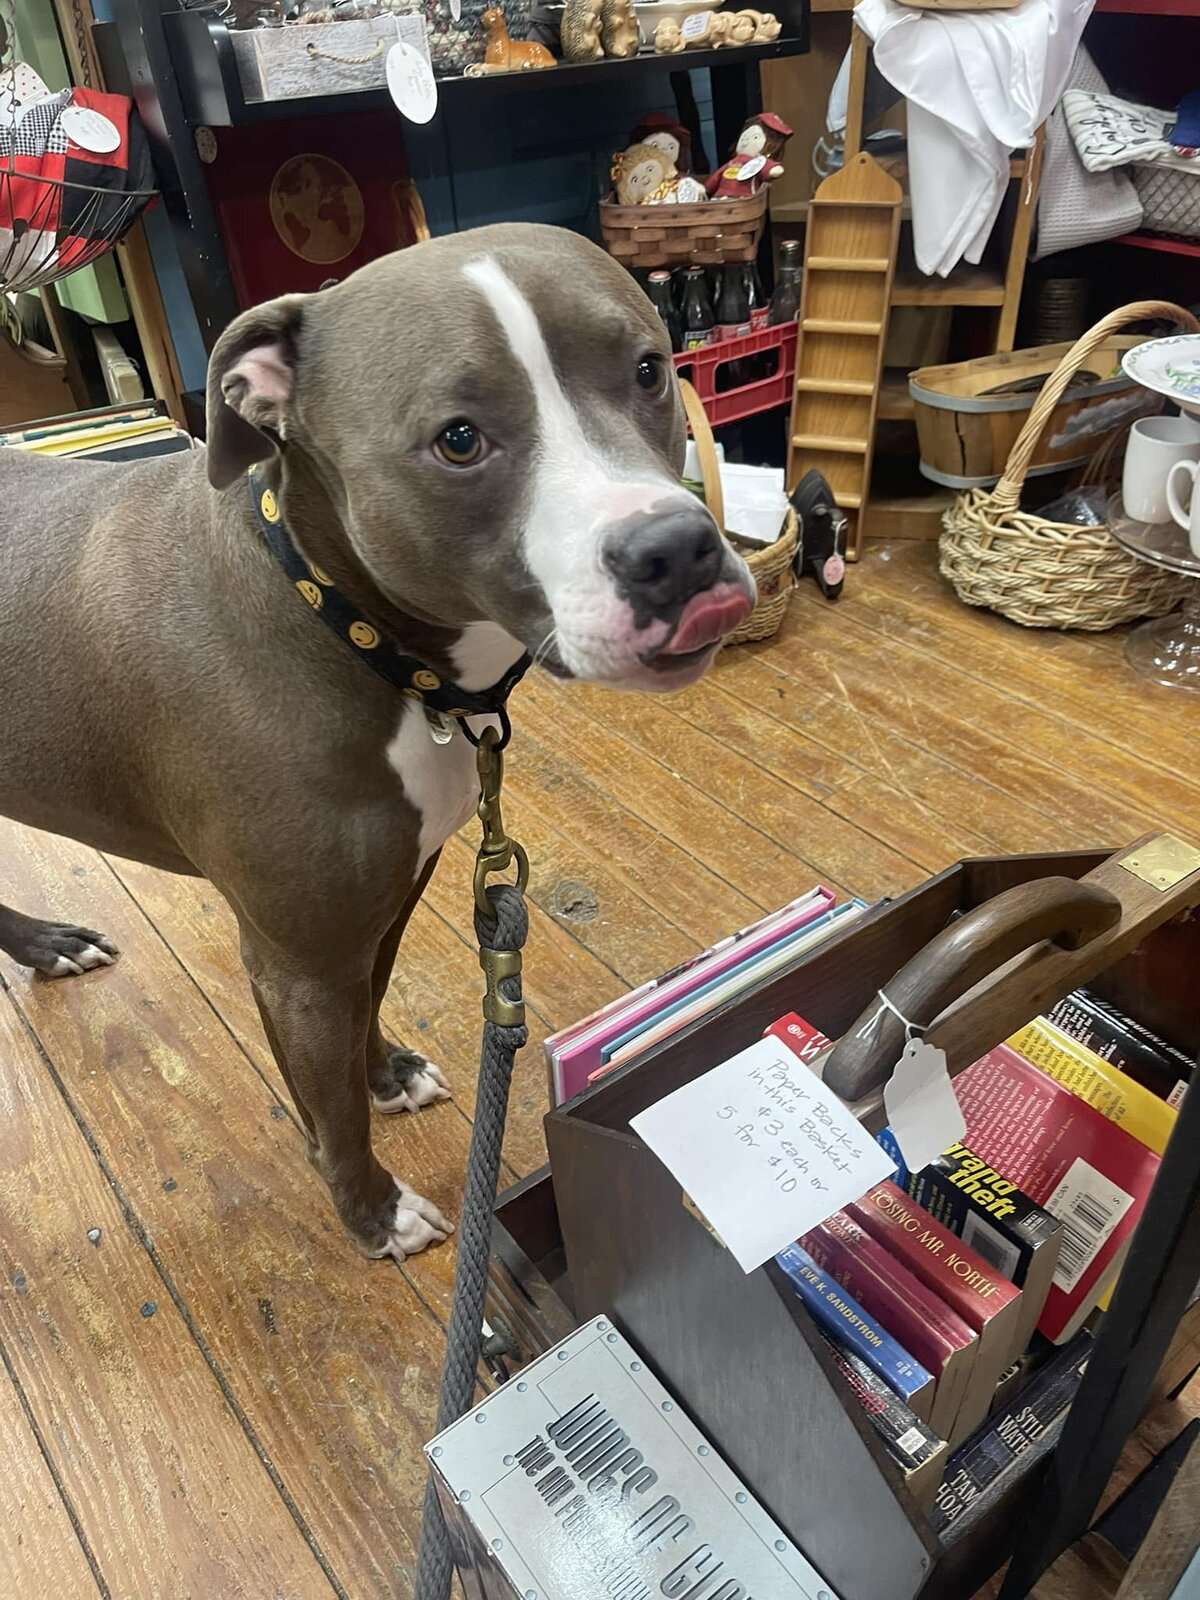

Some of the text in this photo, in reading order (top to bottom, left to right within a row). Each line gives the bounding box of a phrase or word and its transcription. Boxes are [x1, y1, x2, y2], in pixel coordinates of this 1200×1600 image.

[716, 1105, 738, 1120] 5
[733, 1124, 761, 1150] for
[766, 1059, 810, 1100] Paper
[812, 1102, 862, 1160] Backs
[780, 1140, 810, 1174] each
[811, 1178, 829, 1192] or
[799, 1118, 853, 1175] Basket
[948, 1167, 1018, 1221] theft
[916, 1230, 946, 1257] MR.
[943, 1252, 1001, 1299] NORTH
[800, 1266, 817, 1286] EVE
[825, 1292, 883, 1349] SANDSTROM
[997, 1414, 1031, 1456] WATE
[1015, 1405, 1045, 1441] STIL
[534, 1466, 576, 1507] AIR
[935, 1482, 964, 1520] HOA
[950, 1468, 982, 1506] TAM
